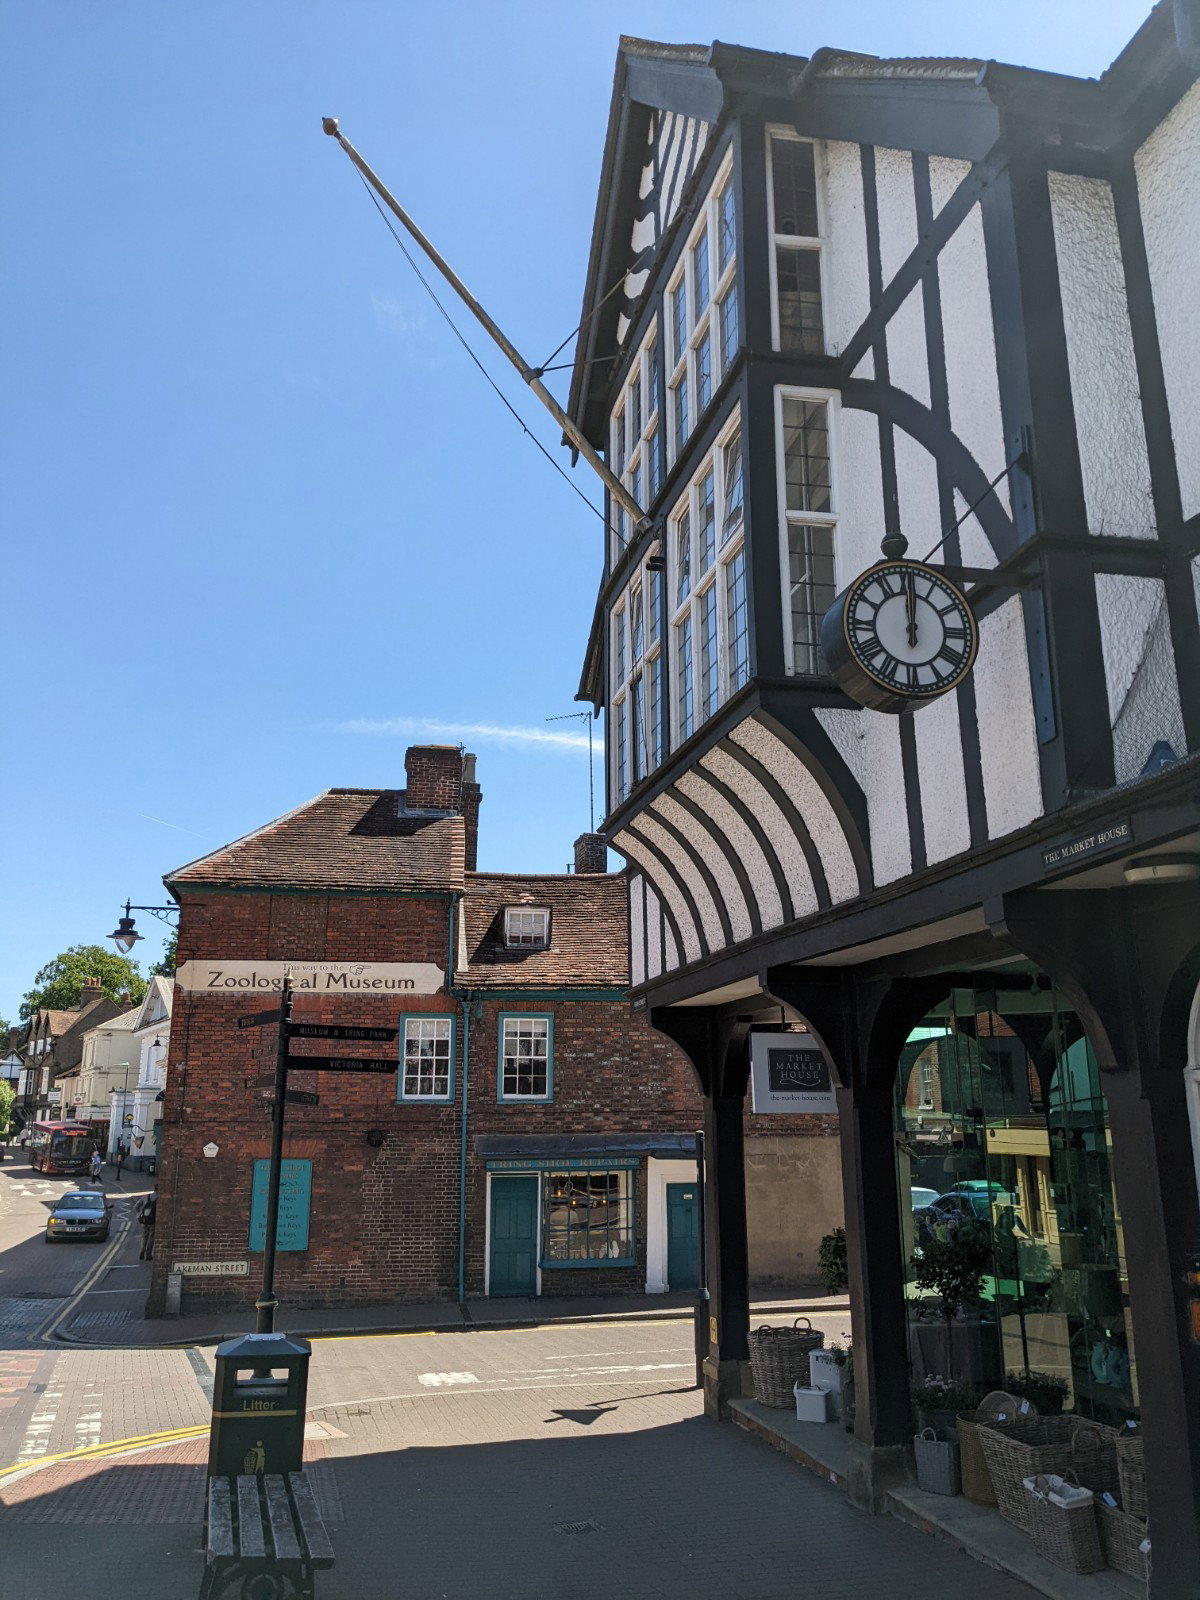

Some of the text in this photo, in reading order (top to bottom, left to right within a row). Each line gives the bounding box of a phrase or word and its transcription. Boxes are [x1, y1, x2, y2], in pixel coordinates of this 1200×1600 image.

[1044, 824, 1128, 864] THE MARKET HOUSE
[325, 972, 415, 989] Museum
[300, 1027, 329, 1036] MUSEUM
[345, 1029, 365, 1038] TRING
[370, 1030, 387, 1038] PARK
[788, 1054, 811, 1062] THE
[329, 1060, 387, 1070] VICTORIA HALL
[776, 1062, 822, 1071] MARKET
[781, 1070, 819, 1079] HOUSE
[493, 1158, 636, 1168] TRING SHOE REPAIRS
[176, 1263, 246, 1273] AKEMAN STREET
[243, 1399, 276, 1411] Litter
